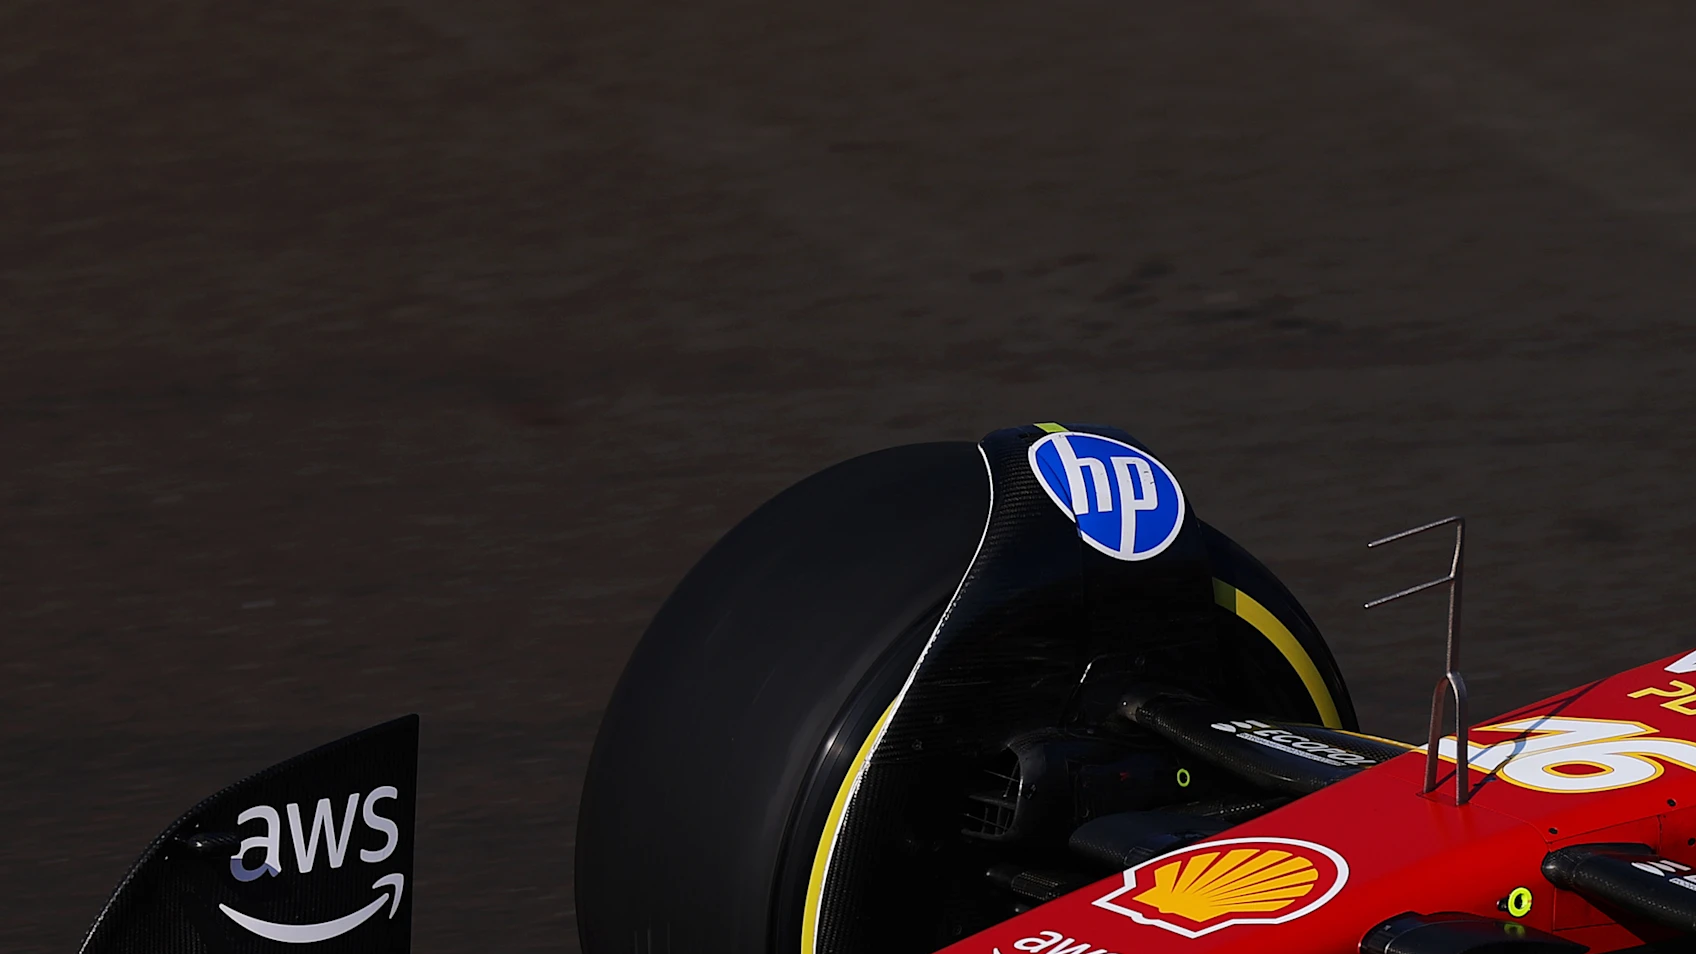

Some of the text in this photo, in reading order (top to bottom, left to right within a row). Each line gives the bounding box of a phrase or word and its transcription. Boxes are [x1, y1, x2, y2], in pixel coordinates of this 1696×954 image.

[1045, 433, 1160, 557] hp
[1254, 729, 1377, 766] ECOPOL
[230, 786, 399, 882] aws
